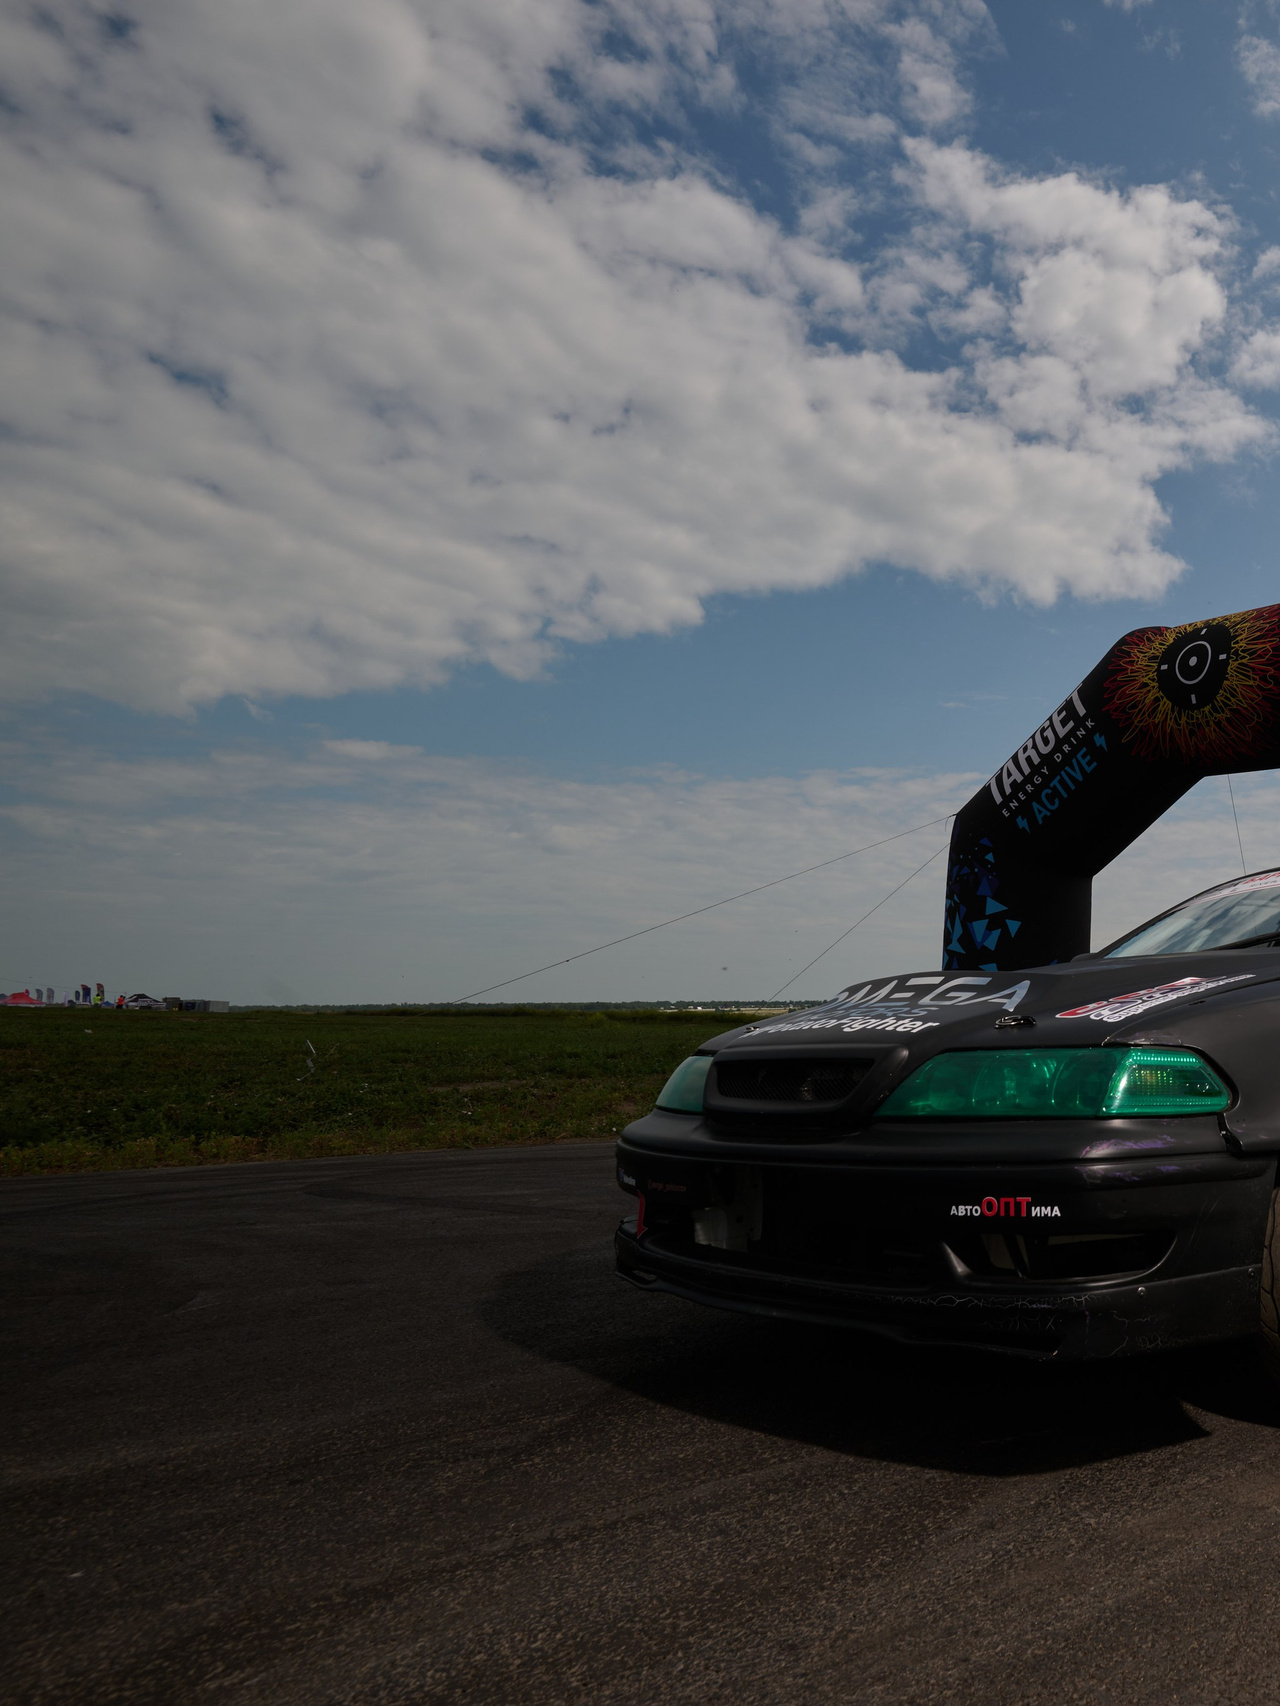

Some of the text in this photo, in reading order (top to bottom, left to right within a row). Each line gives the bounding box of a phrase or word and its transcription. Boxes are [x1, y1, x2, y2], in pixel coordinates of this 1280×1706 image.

[985, 683, 1088, 806] TARGET
[1001, 717, 1096, 818] ENERGY DRINK
[1030, 747, 1098, 826] ACTIVE
